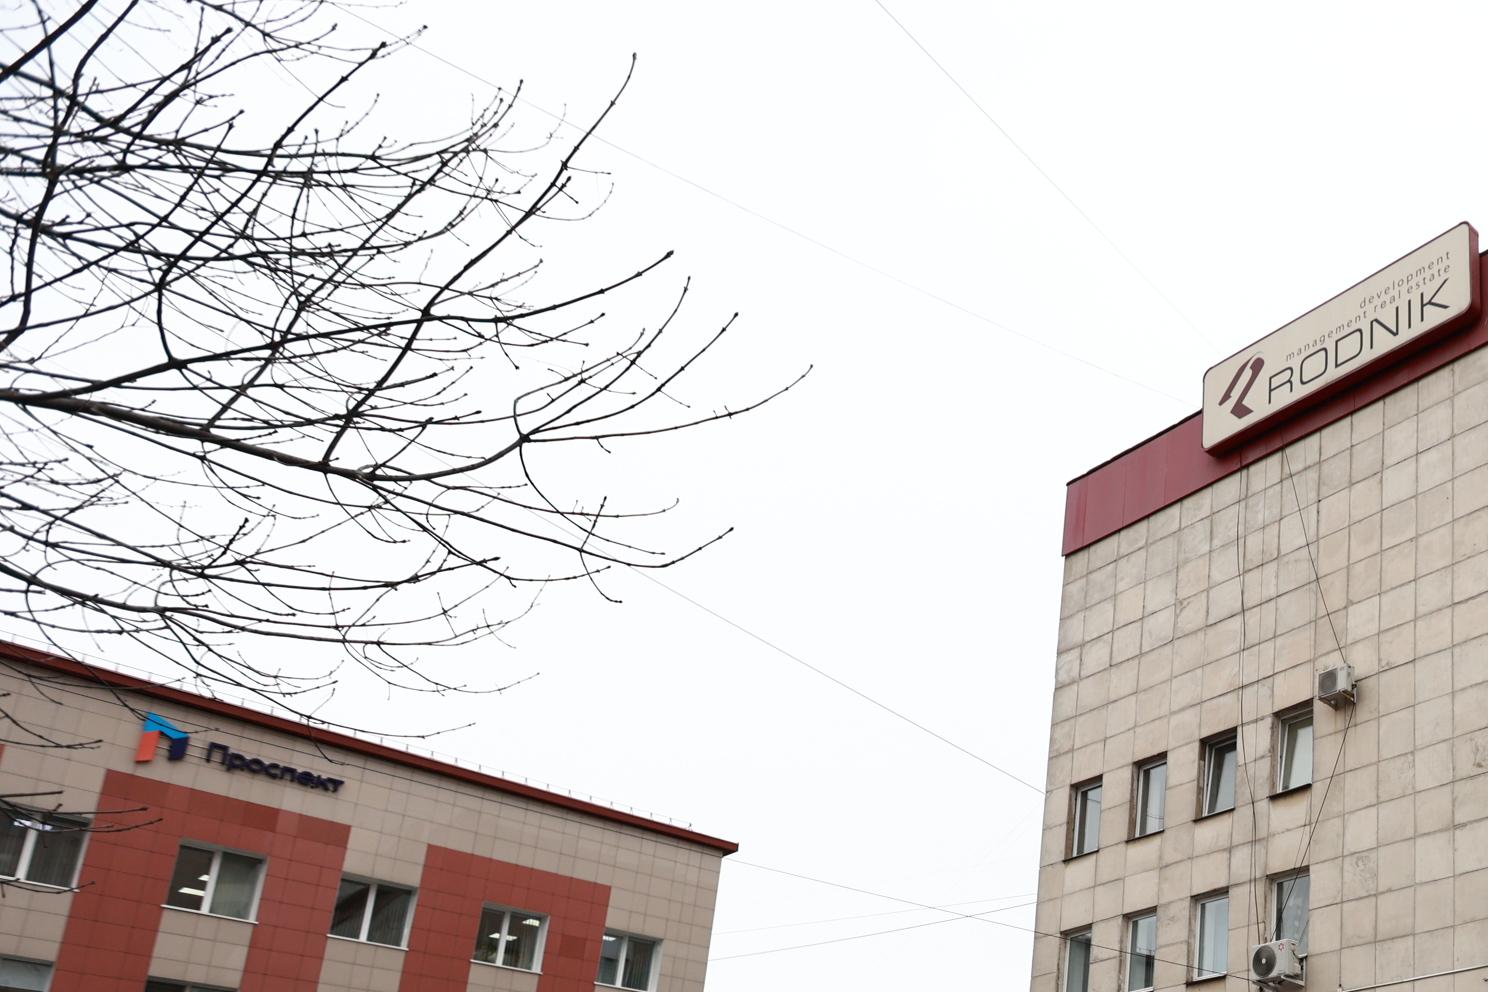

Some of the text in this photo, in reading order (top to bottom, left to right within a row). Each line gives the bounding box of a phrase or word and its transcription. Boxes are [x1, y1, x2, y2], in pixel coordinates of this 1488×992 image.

[1285, 264, 1451, 363] management real estate
[1359, 251, 1450, 309] development
[1267, 277, 1451, 405] RODNIK
[205, 741, 345, 794] Проспект
